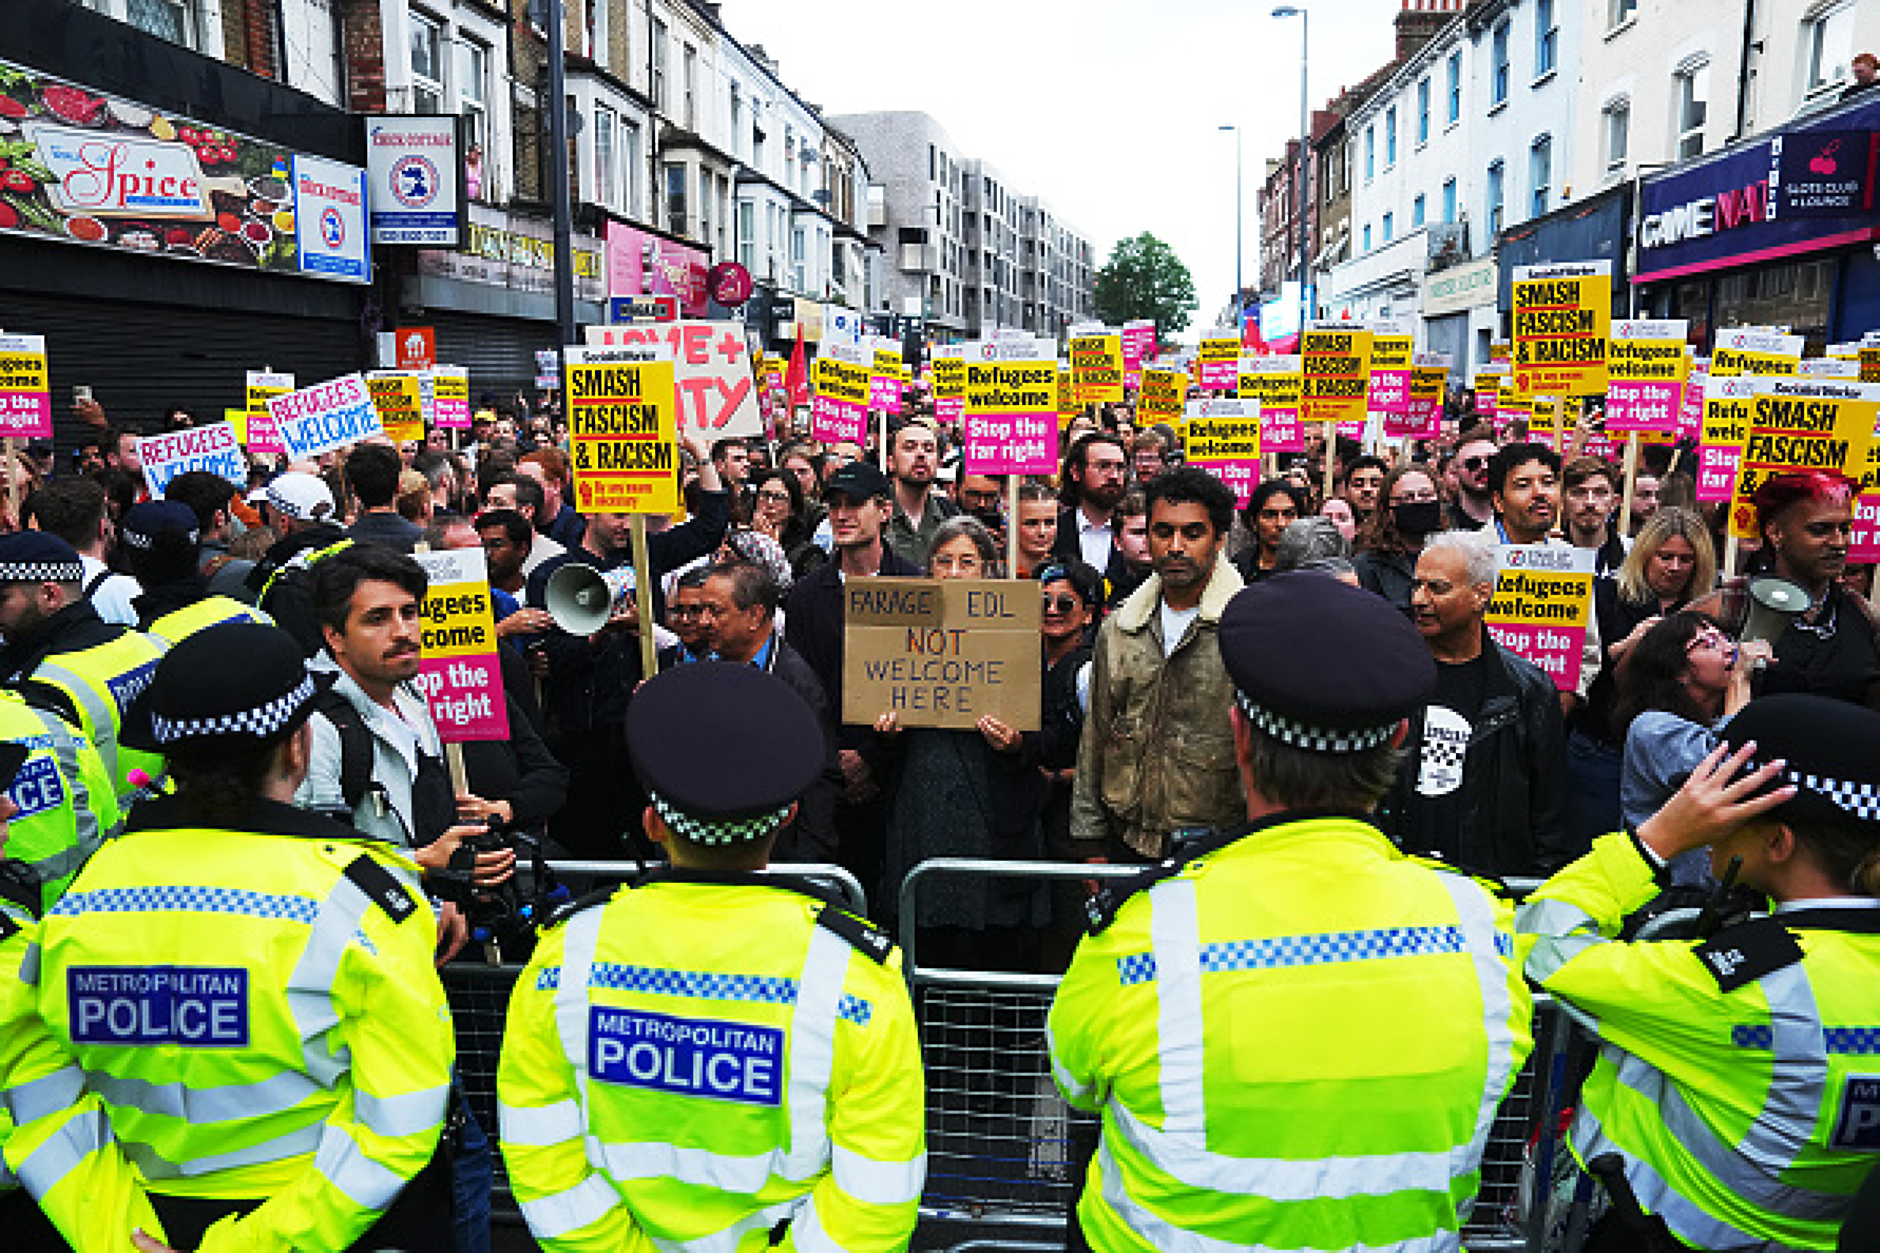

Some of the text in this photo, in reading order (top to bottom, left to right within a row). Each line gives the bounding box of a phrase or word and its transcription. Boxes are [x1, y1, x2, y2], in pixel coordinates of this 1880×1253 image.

[62, 141, 198, 208] Spice
[1516, 282, 1579, 306] SMASH
[1517, 310, 1594, 334] FASCISM
[1516, 338, 1605, 363] & RACISM
[1715, 351, 1793, 374] Refugees
[0, 358, 42, 374] gees
[968, 366, 1054, 389] Refugees
[572, 368, 641, 397] SMASH
[1643, 384, 1672, 400] the
[272, 379, 362, 424] REFUGEES
[968, 388, 1049, 407] welcome
[573, 404, 659, 434] FASCISM
[1627, 401, 1669, 422] right
[1708, 401, 1748, 420] Refu
[1753, 398, 1839, 431] SMASH
[281, 402, 379, 454] WELCOME
[969, 417, 1047, 440] Stop the
[1190, 420, 1257, 440] Refugees
[141, 426, 234, 466] REFUGEES
[575, 442, 672, 469] & RACISM
[970, 439, 1046, 463] far right
[1190, 439, 1254, 457] welcome
[1747, 435, 1849, 468] FASCISM
[1225, 463, 1250, 479] the
[1703, 469, 1729, 488] far
[1740, 470, 1757, 494] &
[419, 594, 486, 624] ugees
[851, 591, 1015, 618] FARAGE EDL
[1490, 597, 1580, 621] welcome
[422, 625, 485, 649] come
[907, 628, 966, 655] NOT
[1537, 629, 1571, 650] the
[447, 661, 489, 688] the
[864, 658, 1004, 684] WELCOME
[434, 692, 494, 726] right
[891, 686, 972, 713] HERE
[15, 772, 61, 811] CE
[75, 973, 239, 995] METROPOLITAN
[78, 998, 240, 1039] POLICE
[597, 1012, 775, 1054] METROPOLITAN
[597, 1037, 774, 1096] POLICE
[1843, 1103, 1880, 1142] P
